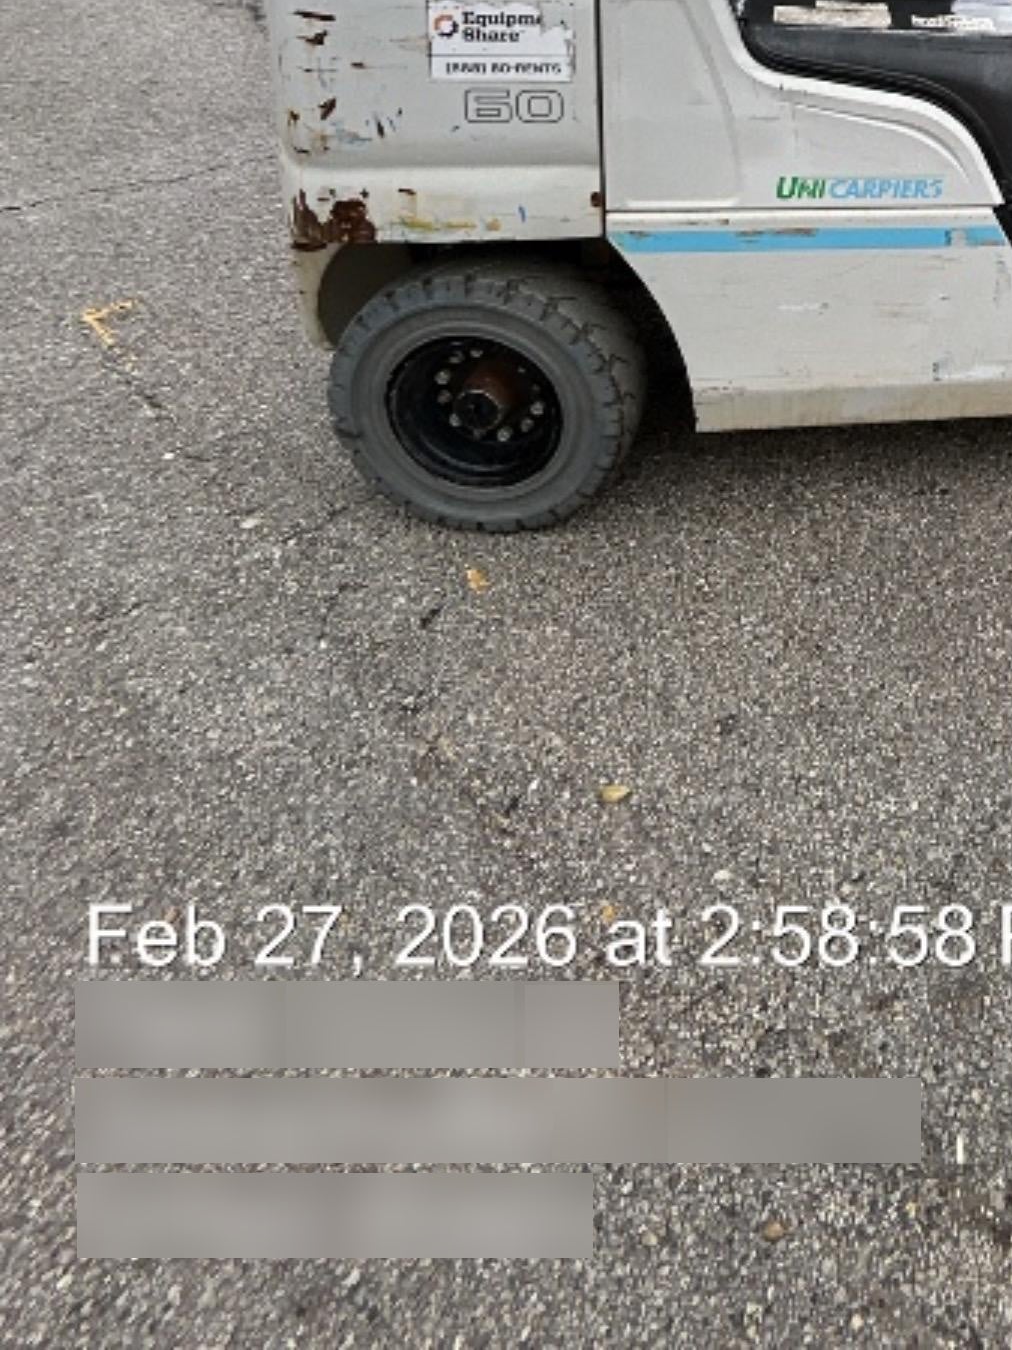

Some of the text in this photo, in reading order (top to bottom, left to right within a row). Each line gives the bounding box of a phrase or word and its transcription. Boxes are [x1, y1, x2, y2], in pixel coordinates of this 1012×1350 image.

[461, 11, 543, 28] Equipm
[462, 27, 520, 42] Share
[464, 88, 564, 124] 60
